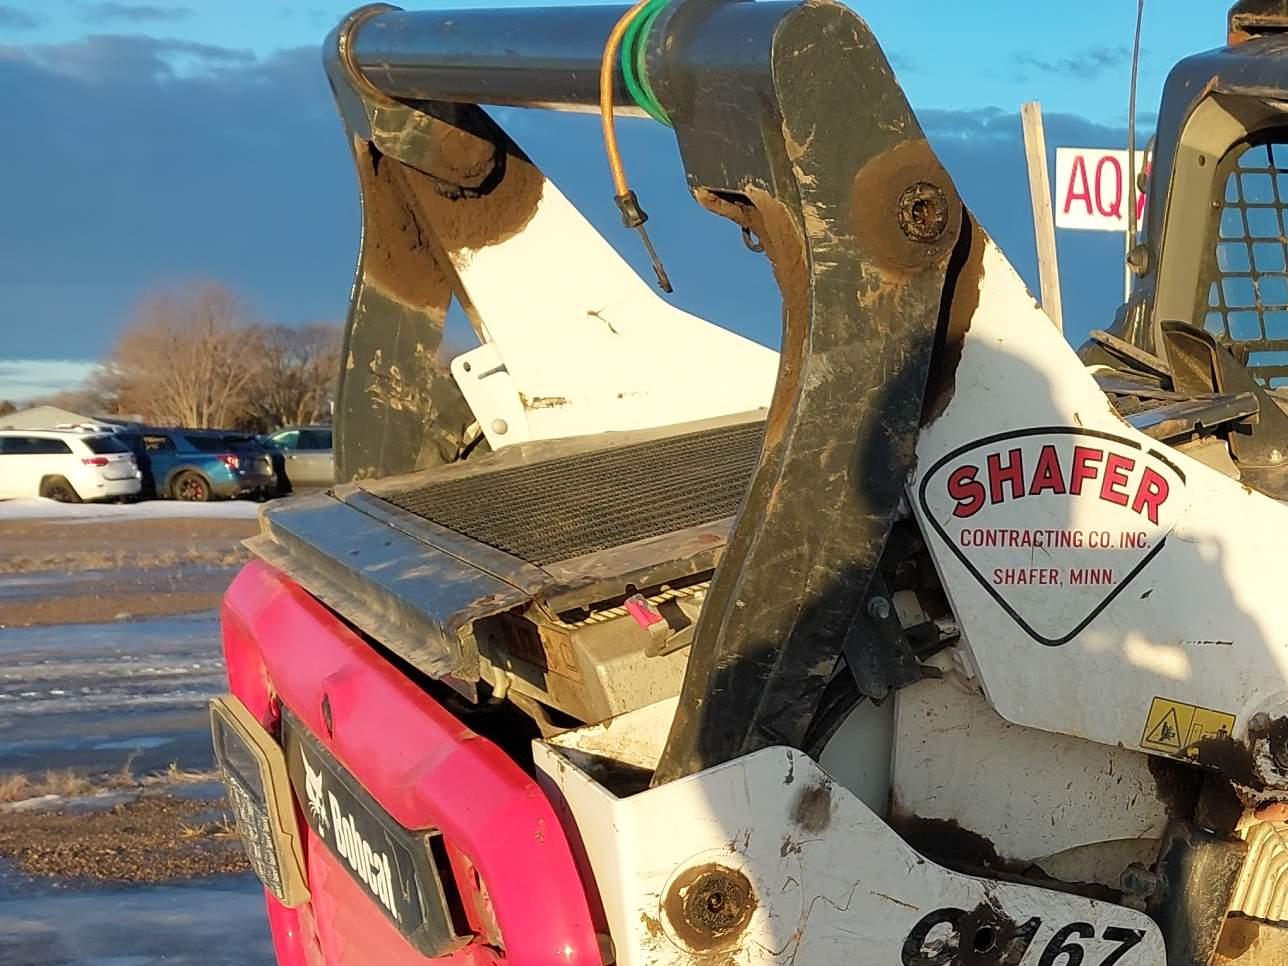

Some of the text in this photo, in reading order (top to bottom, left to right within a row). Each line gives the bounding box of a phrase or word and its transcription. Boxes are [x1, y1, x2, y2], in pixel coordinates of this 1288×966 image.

[947, 444, 1170, 526] SHAFER
[960, 529, 1151, 549] CONTRACTING CO. INC.
[993, 568, 1118, 587] SHAFER, MINN.
[327, 790, 399, 918] Bobcat
